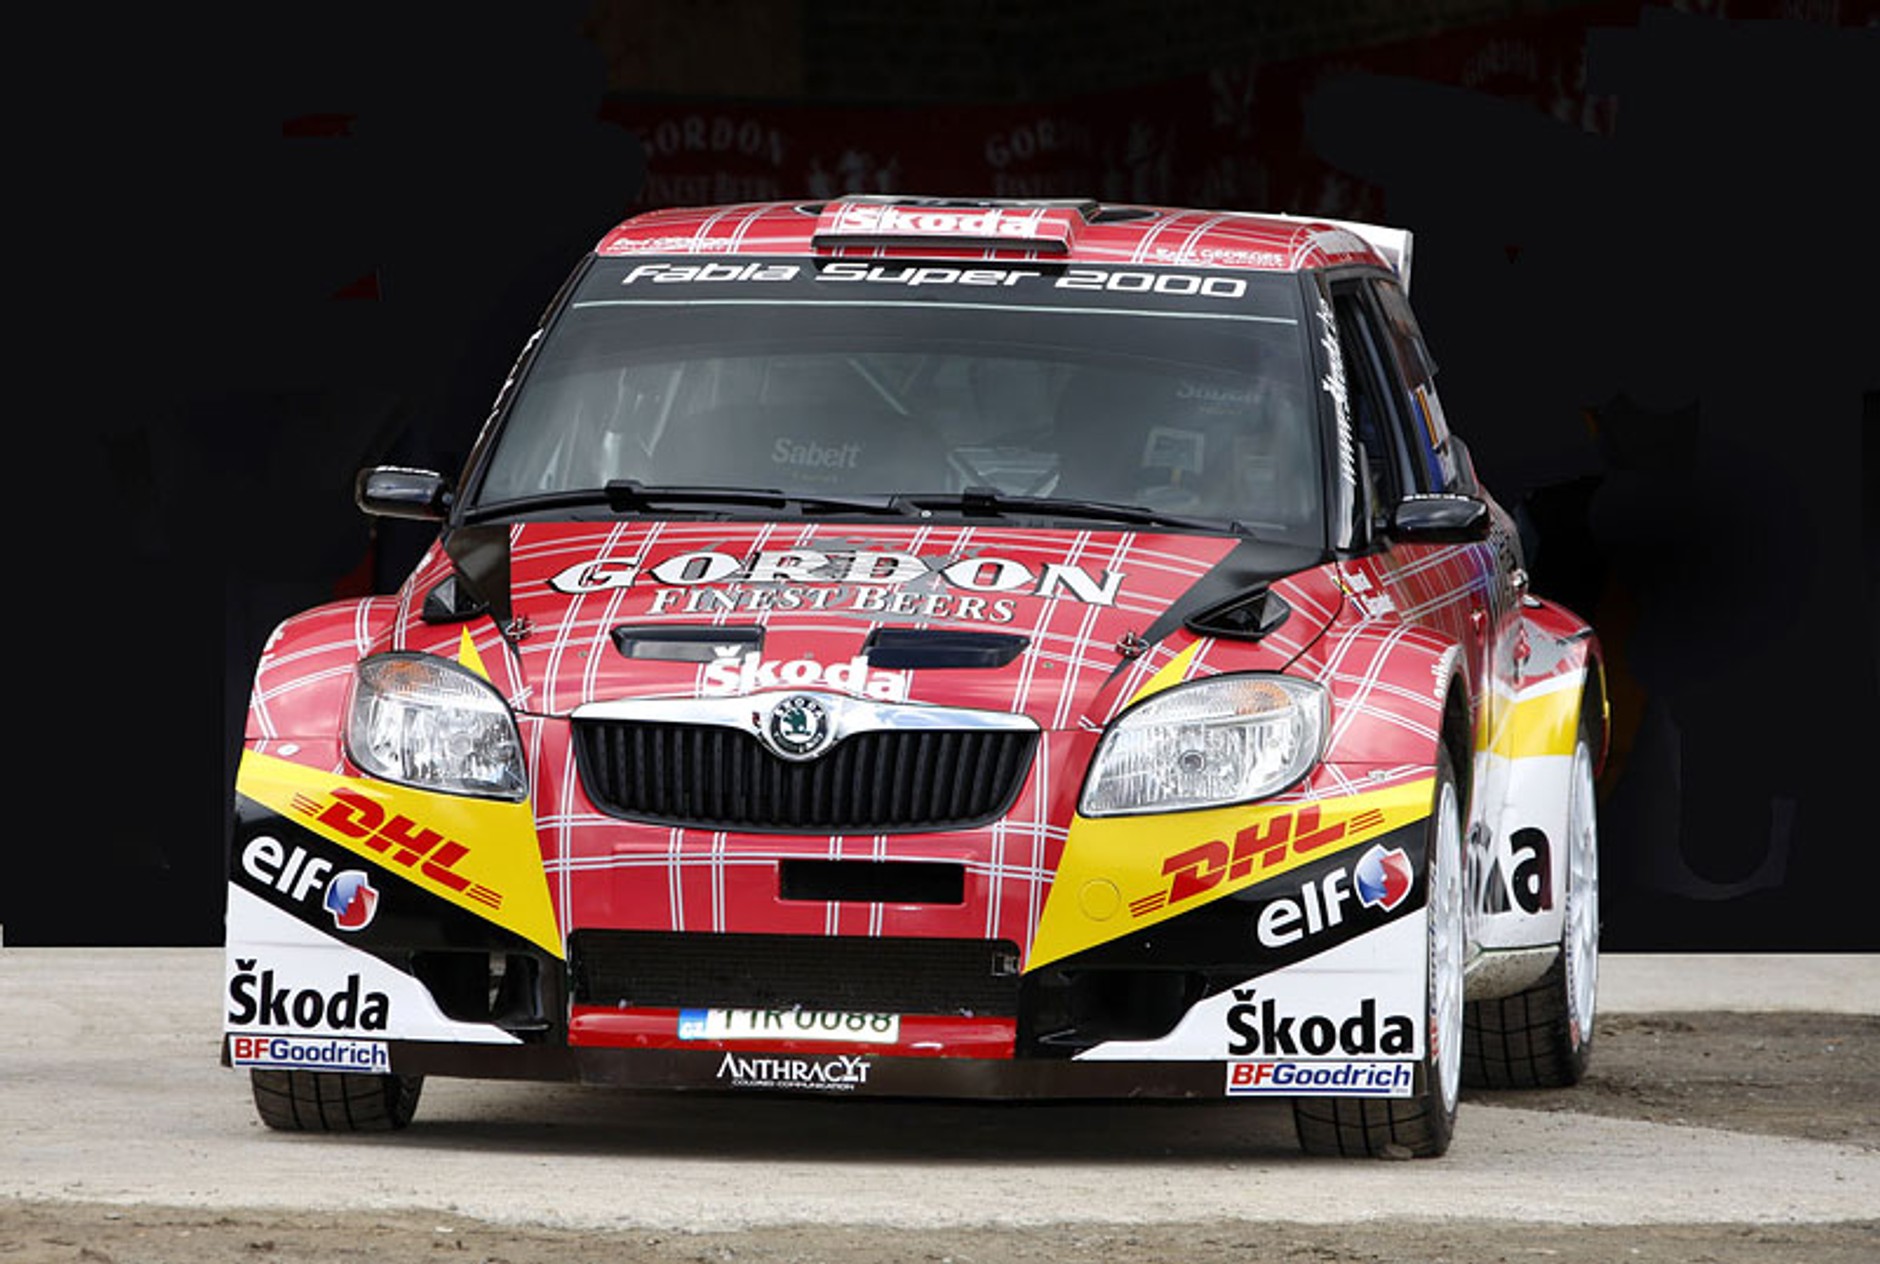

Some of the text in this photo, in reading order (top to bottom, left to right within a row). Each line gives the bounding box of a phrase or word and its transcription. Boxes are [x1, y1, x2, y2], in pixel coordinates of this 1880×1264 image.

[815, 263, 1041, 286] Super
[1055, 270, 1248, 298] 2000
[546, 550, 1126, 606] GORDON
[645, 585, 1017, 624] FINEST BEERS
[703, 643, 906, 704] Škoda
[241, 835, 333, 901] elf
[318, 786, 472, 893] DHL
[1160, 804, 1348, 905] DHL
[1256, 866, 1351, 948] elf
[228, 959, 390, 1030] Škoda
[1226, 989, 1415, 1056] Škoda
[235, 1038, 387, 1065] BFGoodrich
[716, 1051, 871, 1083] ANTHRACYT
[1231, 1063, 1411, 1086] BFGoodrich
